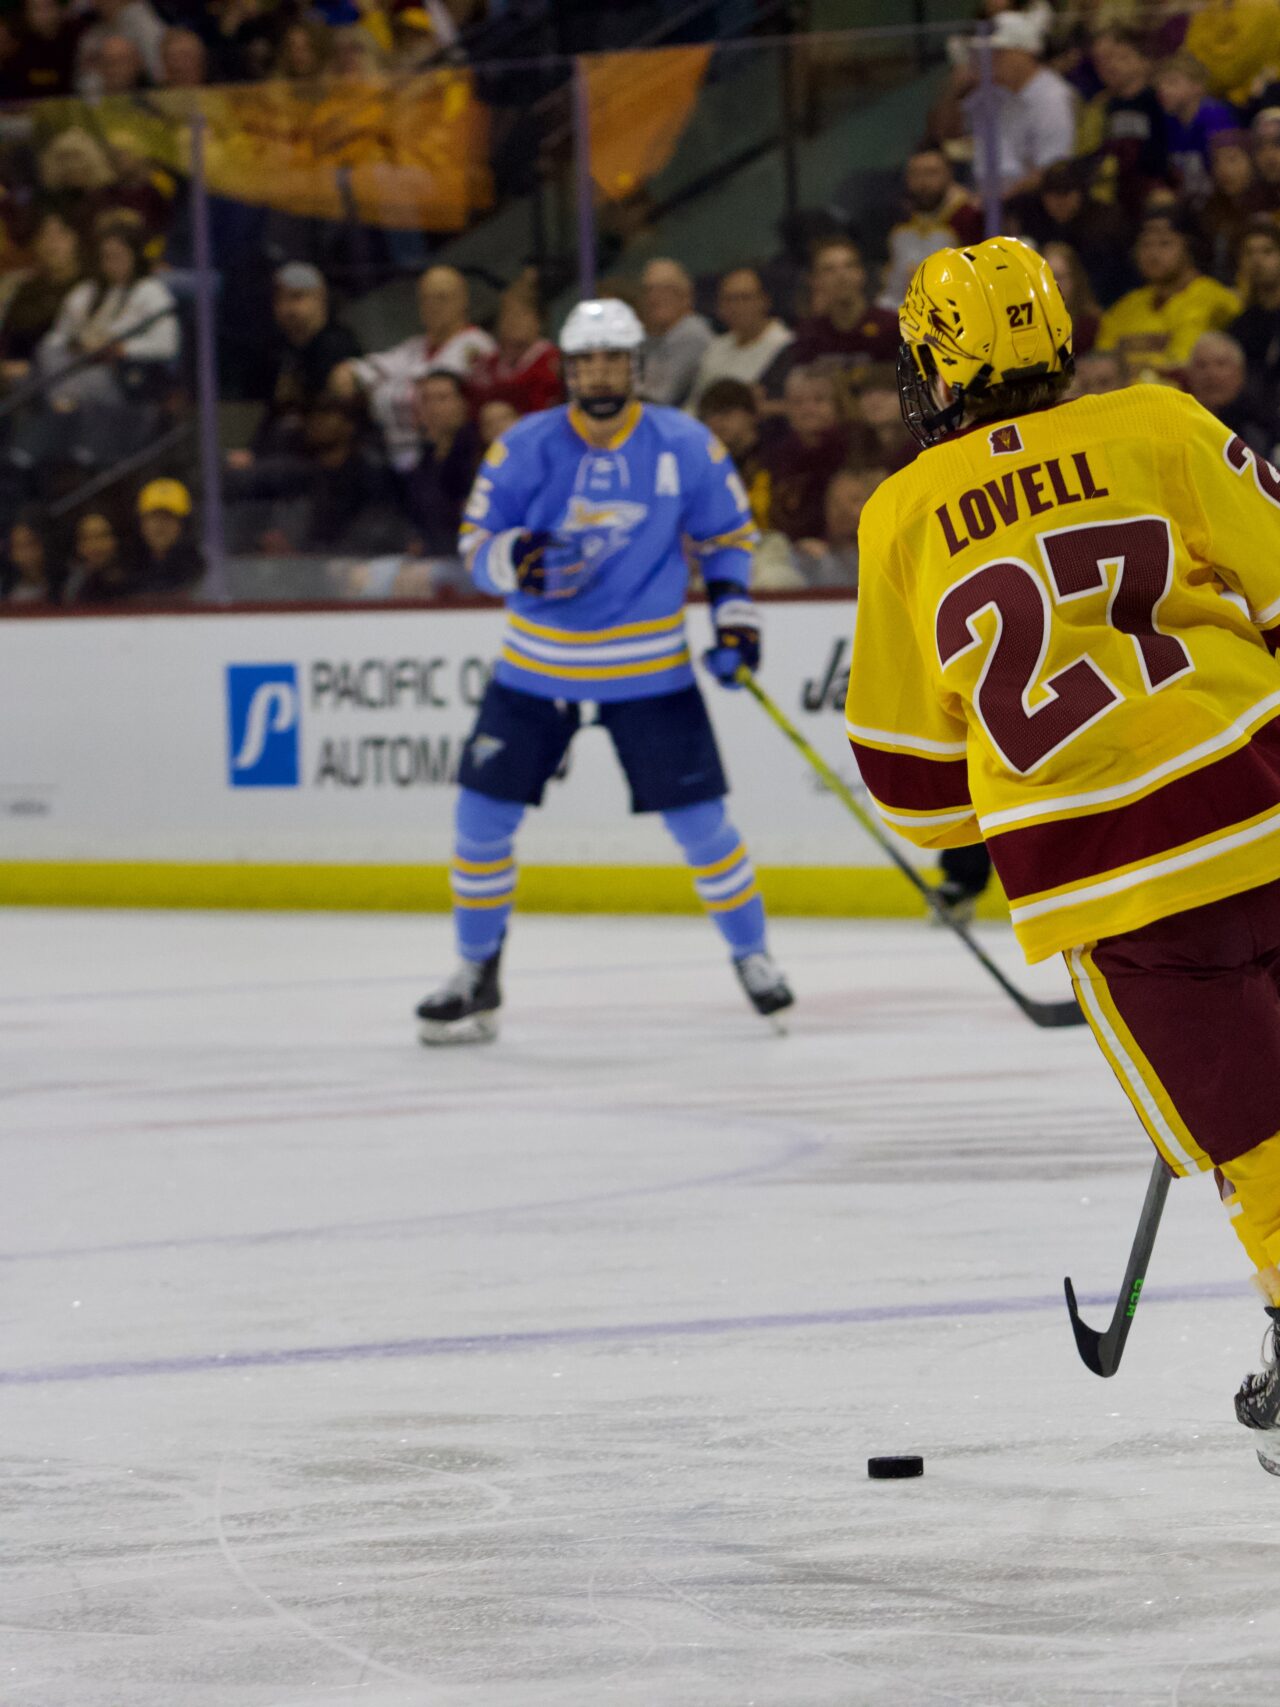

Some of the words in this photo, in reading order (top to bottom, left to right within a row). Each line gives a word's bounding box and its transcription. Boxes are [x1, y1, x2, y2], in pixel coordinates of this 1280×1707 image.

[1006, 302, 1034, 329] 27
[935, 450, 1110, 558] LOVELL
[311, 659, 447, 709] PACIFIC
[936, 514, 1196, 776] 27
